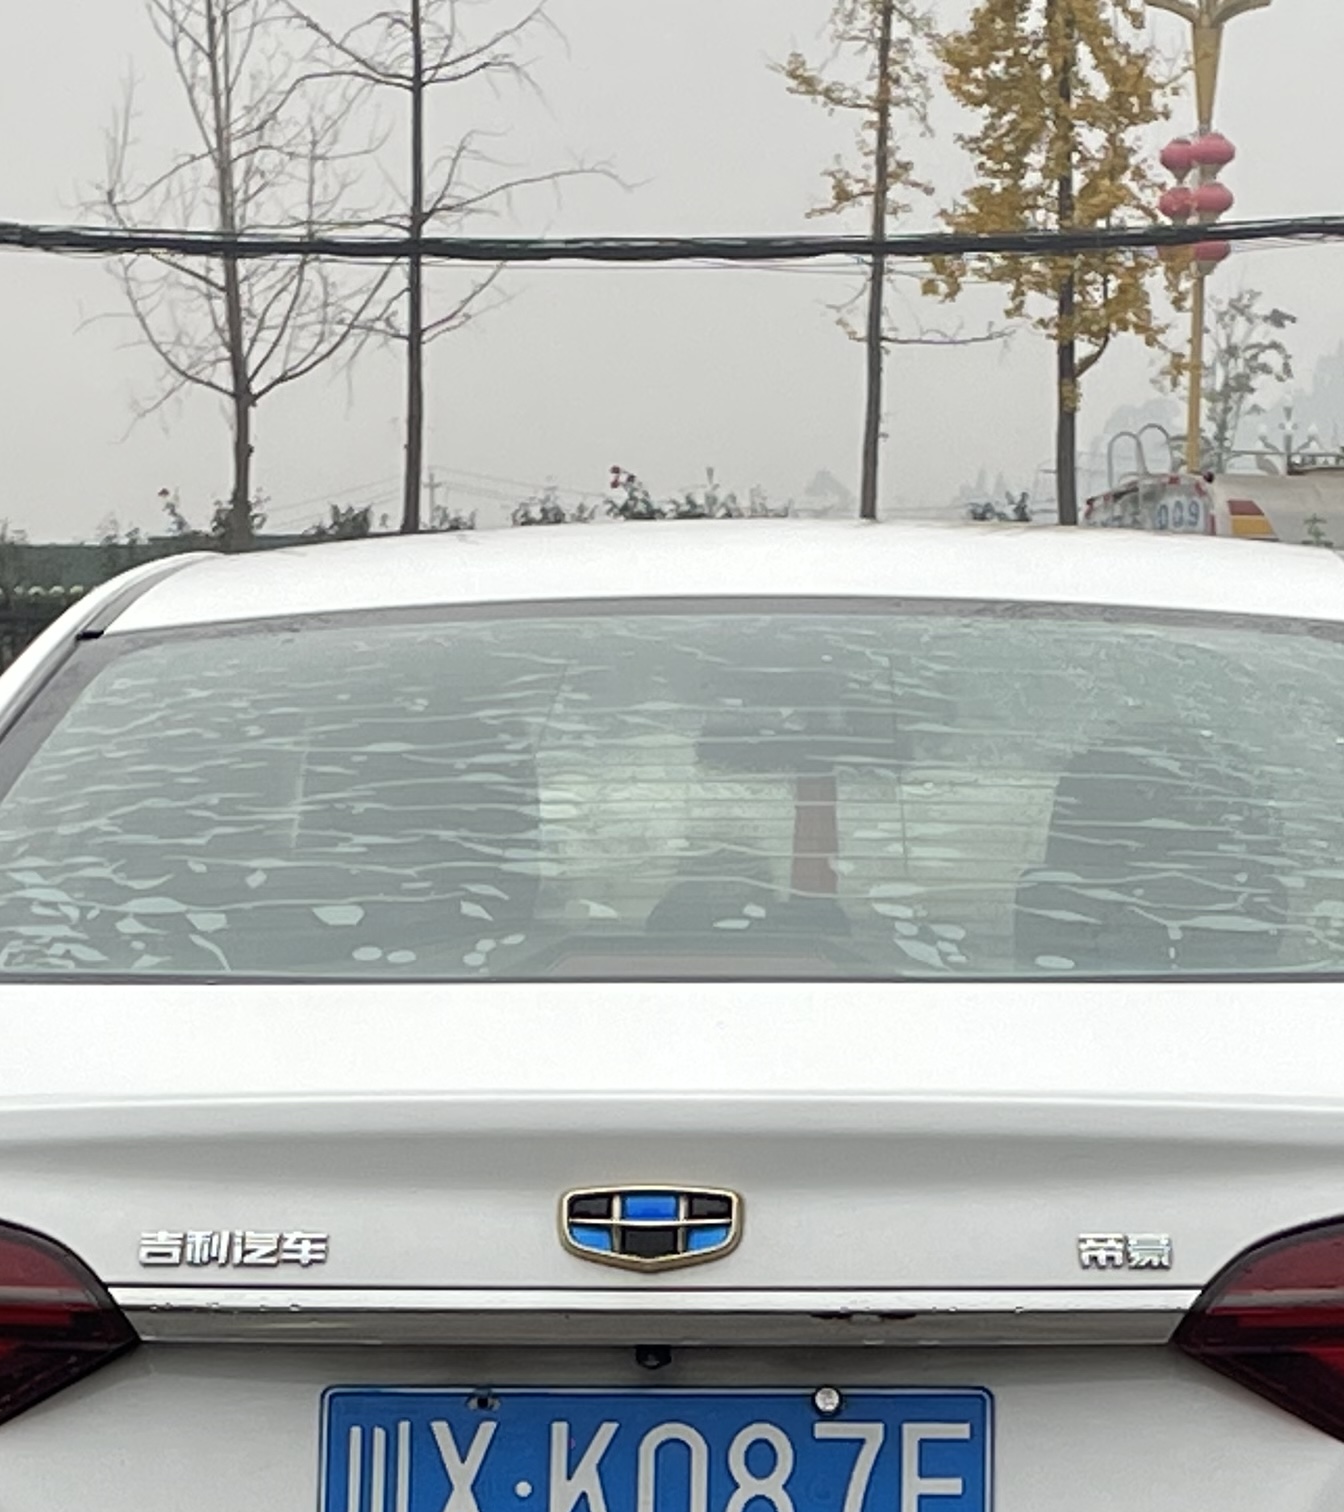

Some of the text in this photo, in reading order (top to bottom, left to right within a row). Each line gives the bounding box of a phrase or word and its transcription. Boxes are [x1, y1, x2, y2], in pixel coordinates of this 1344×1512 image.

[139, 1230, 329, 1267] 吉利汽车
[1078, 1233, 1172, 1269] 帝豪
